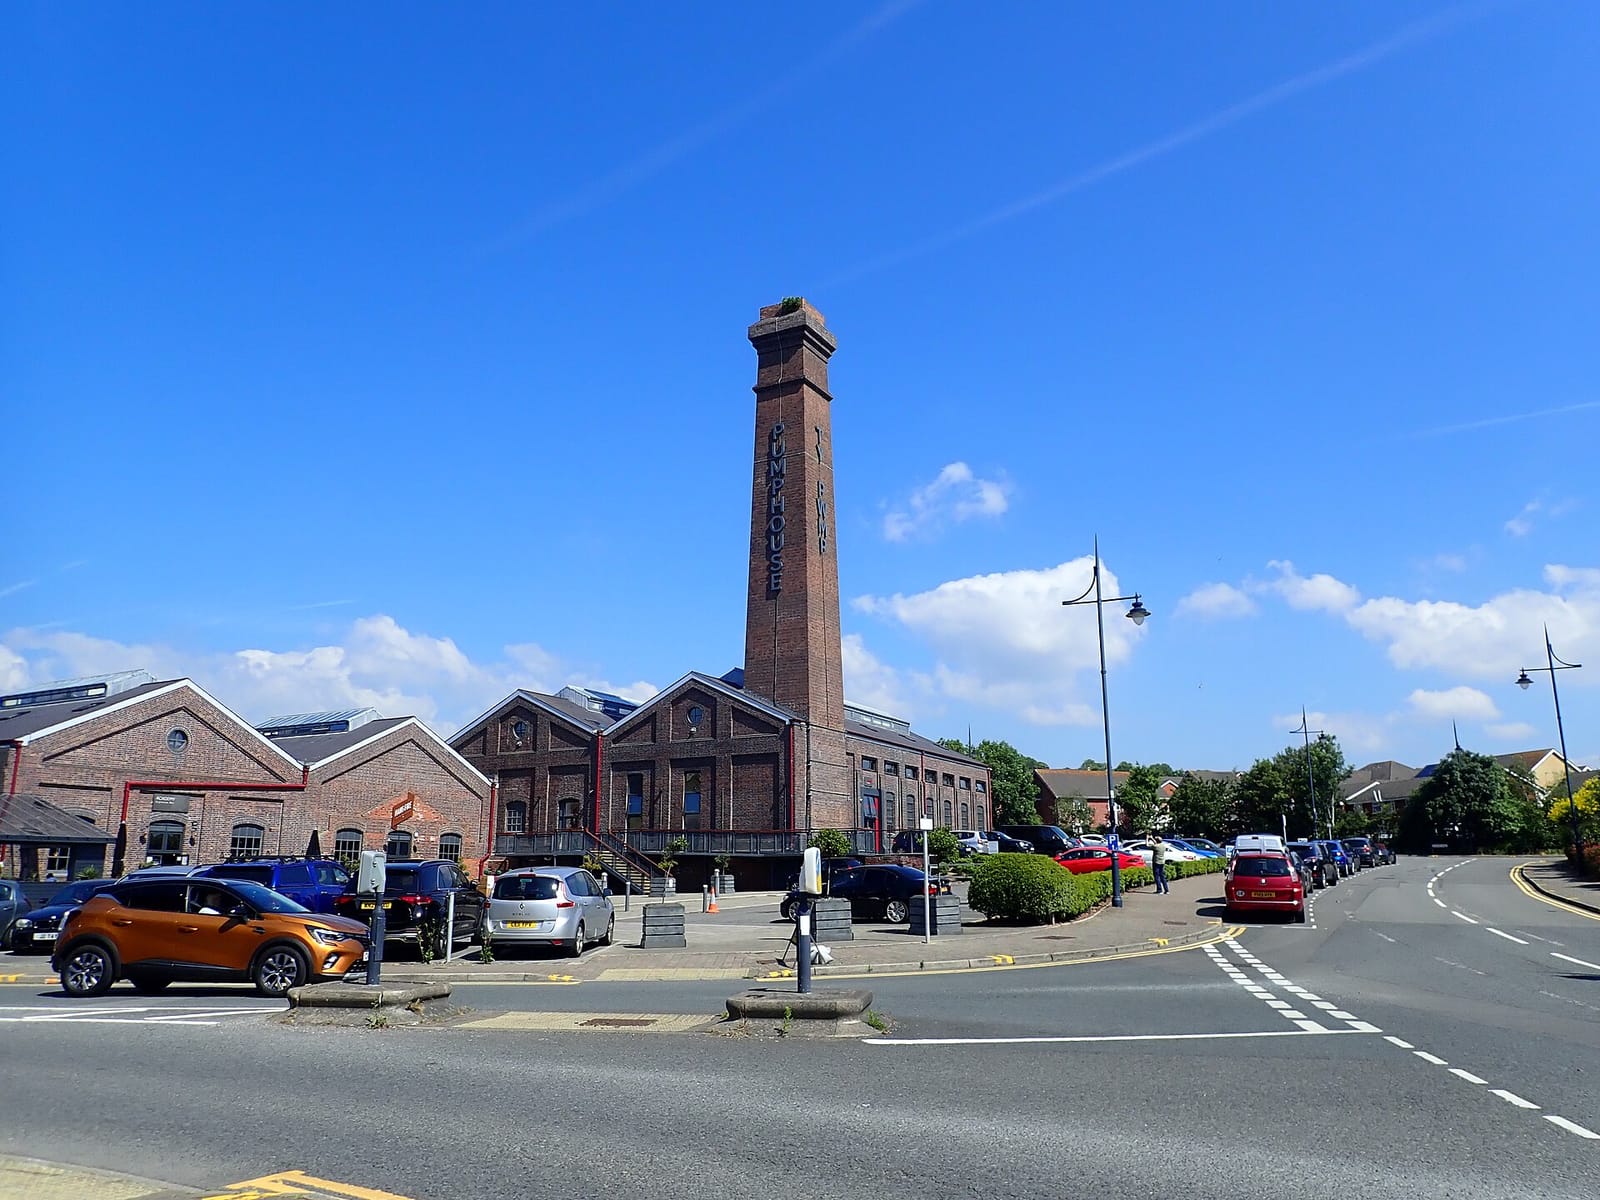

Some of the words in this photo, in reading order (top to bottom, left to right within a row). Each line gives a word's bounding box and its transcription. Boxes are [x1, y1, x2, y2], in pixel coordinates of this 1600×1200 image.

[815, 426, 824, 464] TY
[770, 423, 786, 591] PUMPHOUSE
[817, 480, 828, 554] PWMP
